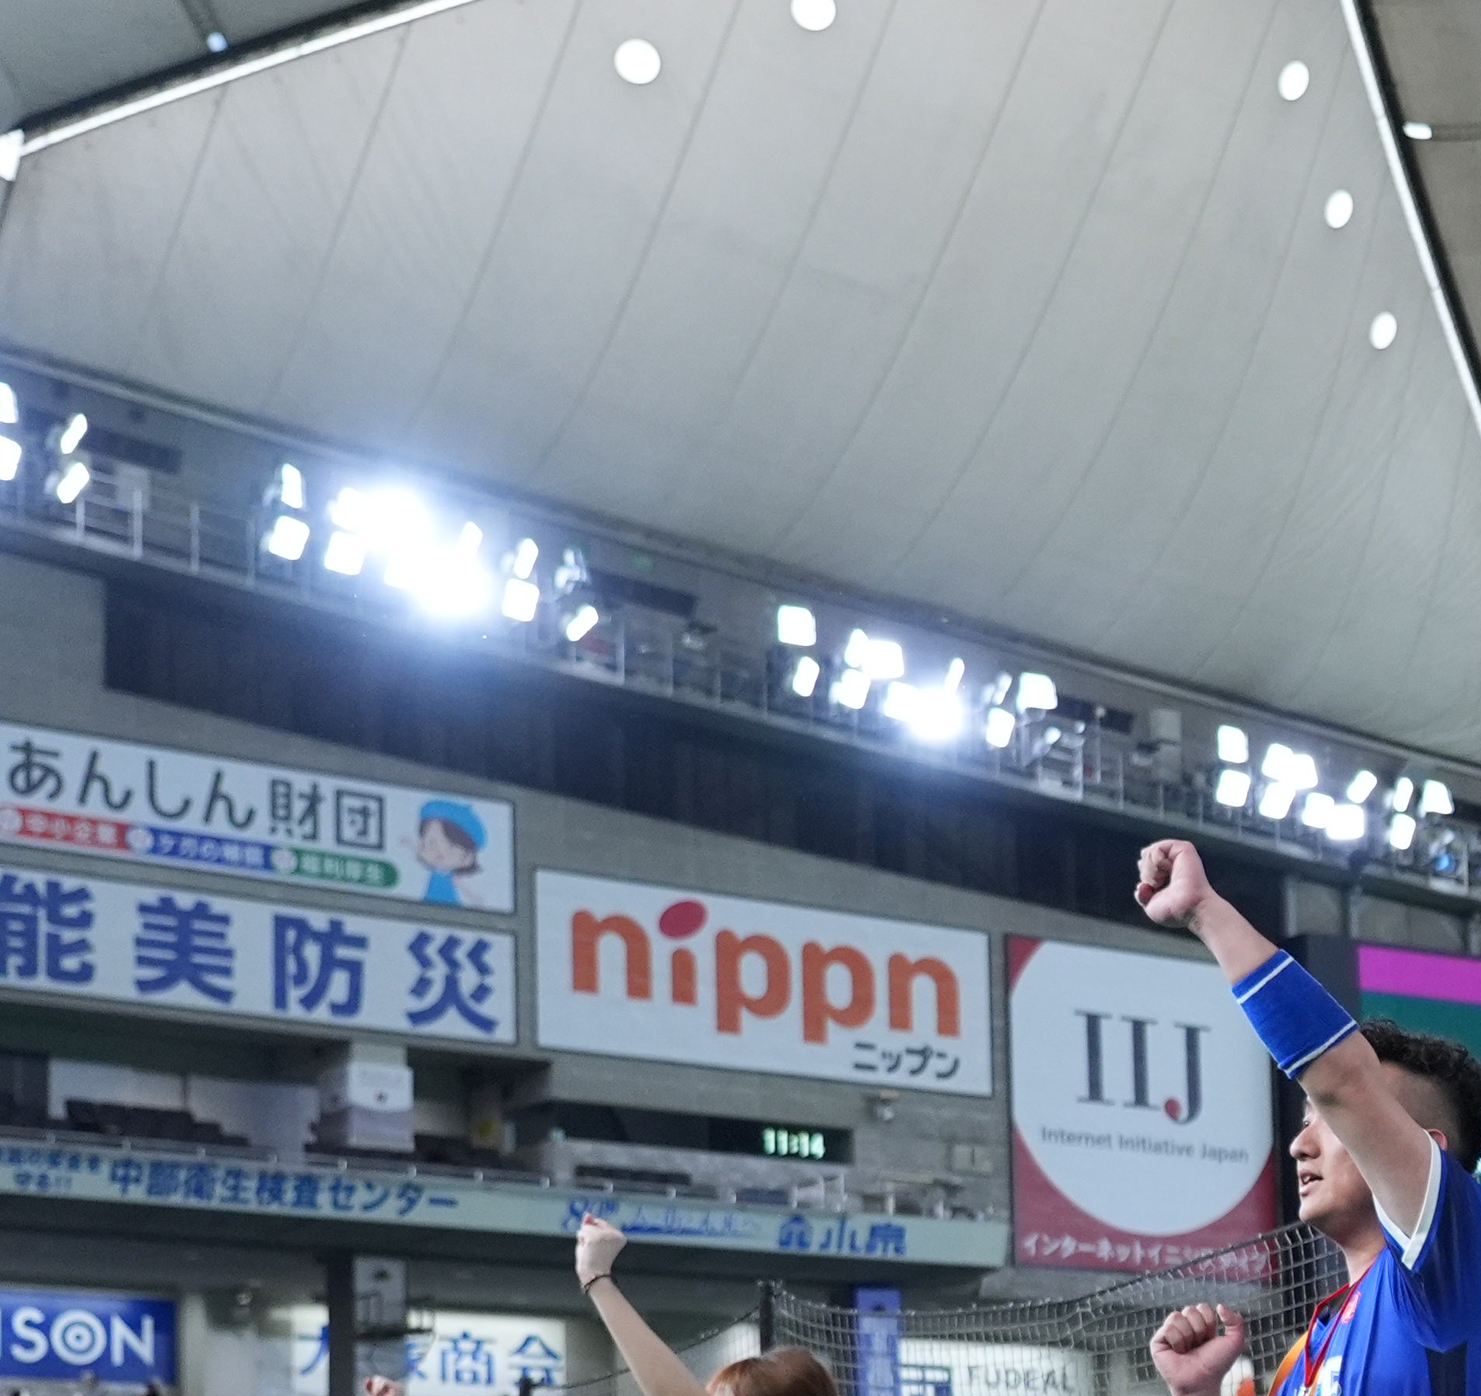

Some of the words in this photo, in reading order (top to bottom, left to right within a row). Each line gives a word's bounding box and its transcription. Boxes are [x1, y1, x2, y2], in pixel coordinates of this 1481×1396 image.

[8, 737, 387, 851] あんしん財団
[0, 874, 500, 1034] 能美防災
[571, 900, 961, 1043] nippn
[852, 1042, 961, 1081] ニップン
[1074, 1008, 1212, 1125] IIJ
[762, 1127, 826, 1159] 11:14
[1040, 1127, 1112, 1149] Internet
[1118, 1131, 1195, 1158] Initiative
[1200, 1144, 1250, 1166] Japan
[10, 1306, 155, 1367] SON
